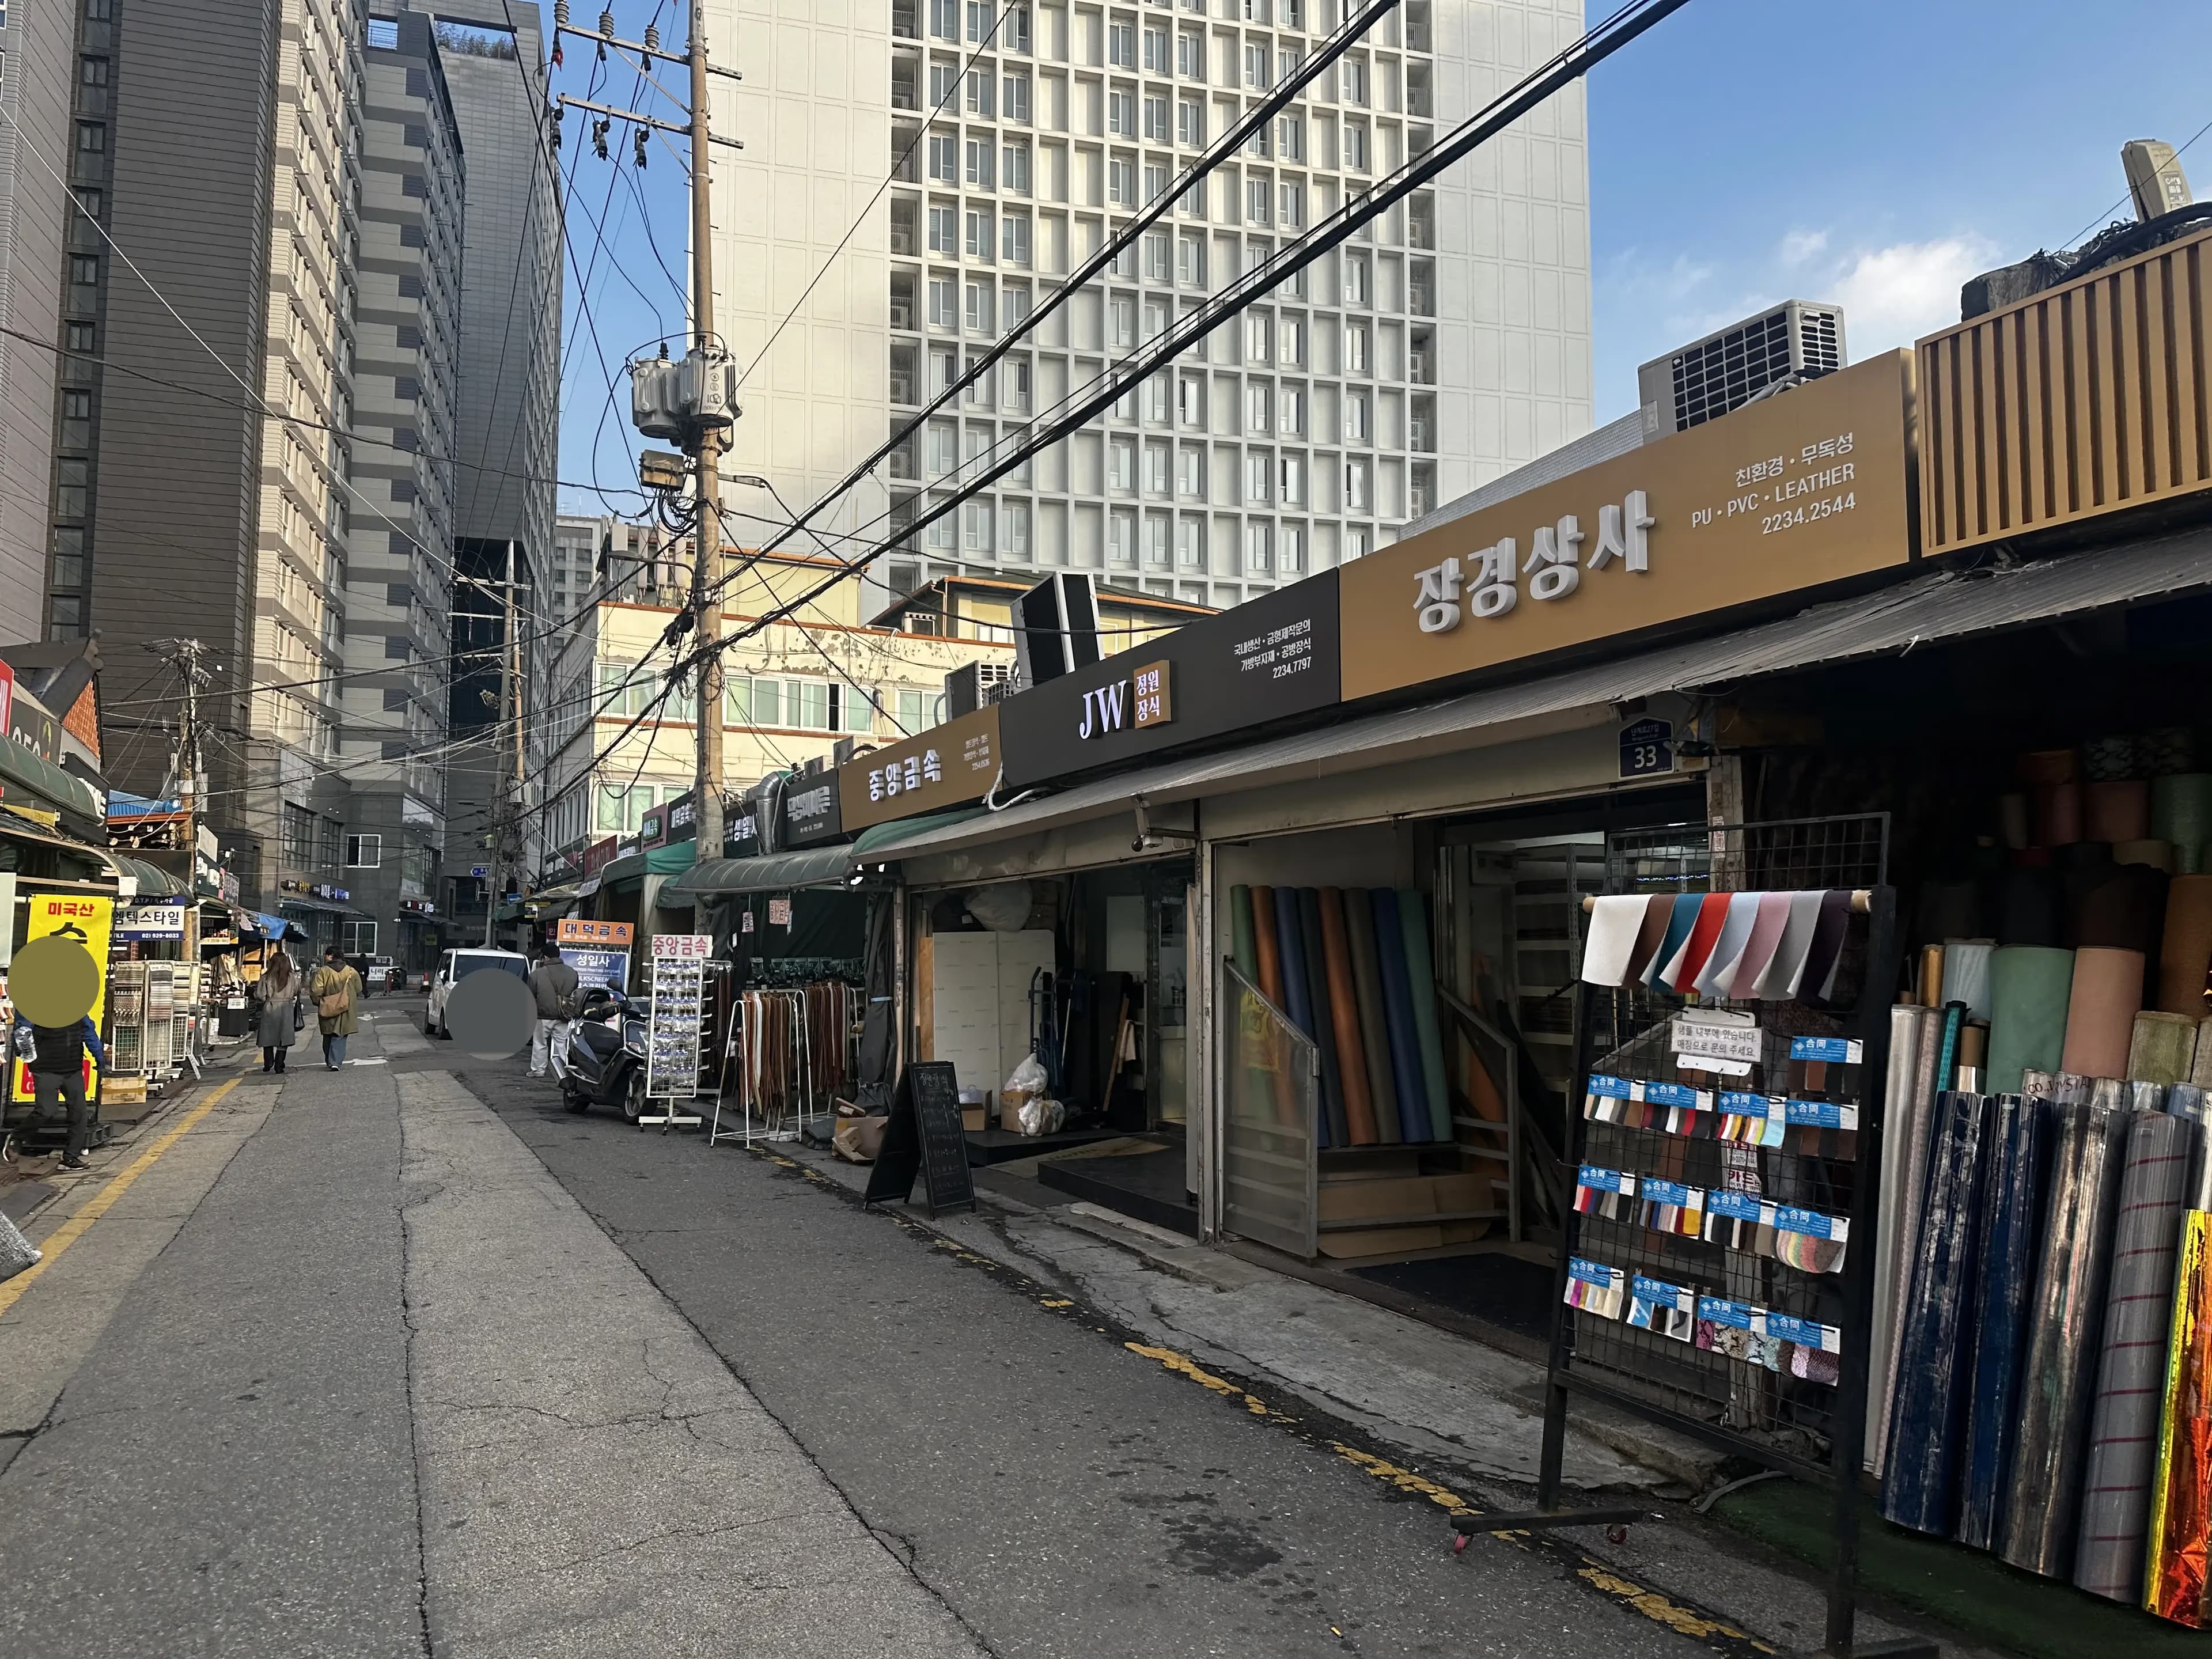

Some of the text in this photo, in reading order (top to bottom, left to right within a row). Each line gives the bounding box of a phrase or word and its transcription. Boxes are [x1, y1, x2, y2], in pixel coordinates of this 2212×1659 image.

[1735, 432, 1853, 487] 친환경 무독성
[1692, 463, 1855, 528] PU PVC LEATHER
[1762, 492, 1856, 535] 2234.2544
[1413, 490, 1655, 634] 장경상사
[1234, 619, 1311, 656] 국내생산 금형제작문의
[1240, 637, 1312, 672] 가방부자재 공방장식
[1272, 657, 1312, 679] 2234.7797
[1137, 669, 1160, 696] 정원
[1080, 680, 1127, 740] JW
[1137, 695, 1161, 722] 장식
[1634, 745, 1657, 769] 33
[869, 749, 941, 801] 중앙금속
[48, 902, 95, 917] 미국산
[565, 923, 627, 937] 대덕금속
[653, 936, 707, 956] 중앙금속
[577, 954, 611, 967] 성일사
[1696, 1028, 1719, 1039] 내부에
[1677, 1039, 1709, 1052] 매장으로
[1710, 1043, 1727, 1054] 문의
[1806, 1039, 1826, 1049] 合同
[1599, 1077, 1615, 1088] 合同
[1659, 1085, 1677, 1095] 合同
[1731, 1094, 1750, 1105] 合同
[1798, 1103, 1819, 1114] 合同
[1589, 1168, 1605, 1179] 合同
[1653, 1181, 1670, 1192] 合同
[1721, 1195, 1741, 1206] 合同
[1789, 1210, 1810, 1222] 合同
[1579, 1262, 1595, 1273] 合同
[1643, 1280, 1660, 1293] 合同
[1712, 1300, 1730, 1313] 合同
[1779, 1317, 1800, 1331] 合同
